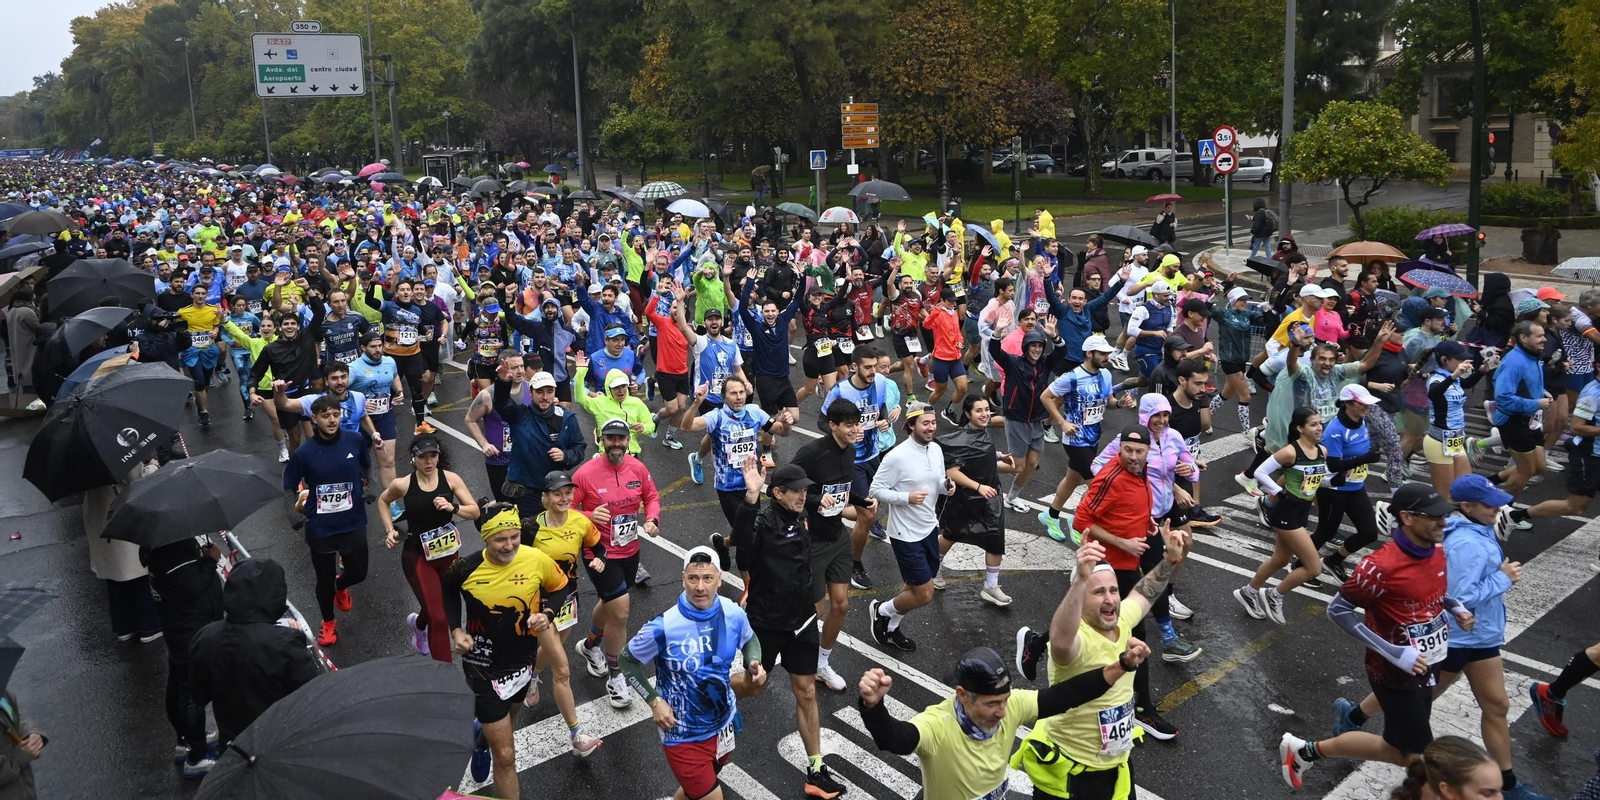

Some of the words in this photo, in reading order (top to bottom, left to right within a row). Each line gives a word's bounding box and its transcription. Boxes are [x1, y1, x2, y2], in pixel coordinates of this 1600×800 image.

[1217, 133, 1228, 142] 3,5
[731, 442, 755, 454] 4592
[321, 492, 348, 503] 4784
[618, 522, 637, 536] 274
[428, 532, 456, 551] 5175
[666, 632, 713, 657] CÓR
[1417, 627, 1449, 653] 3916
